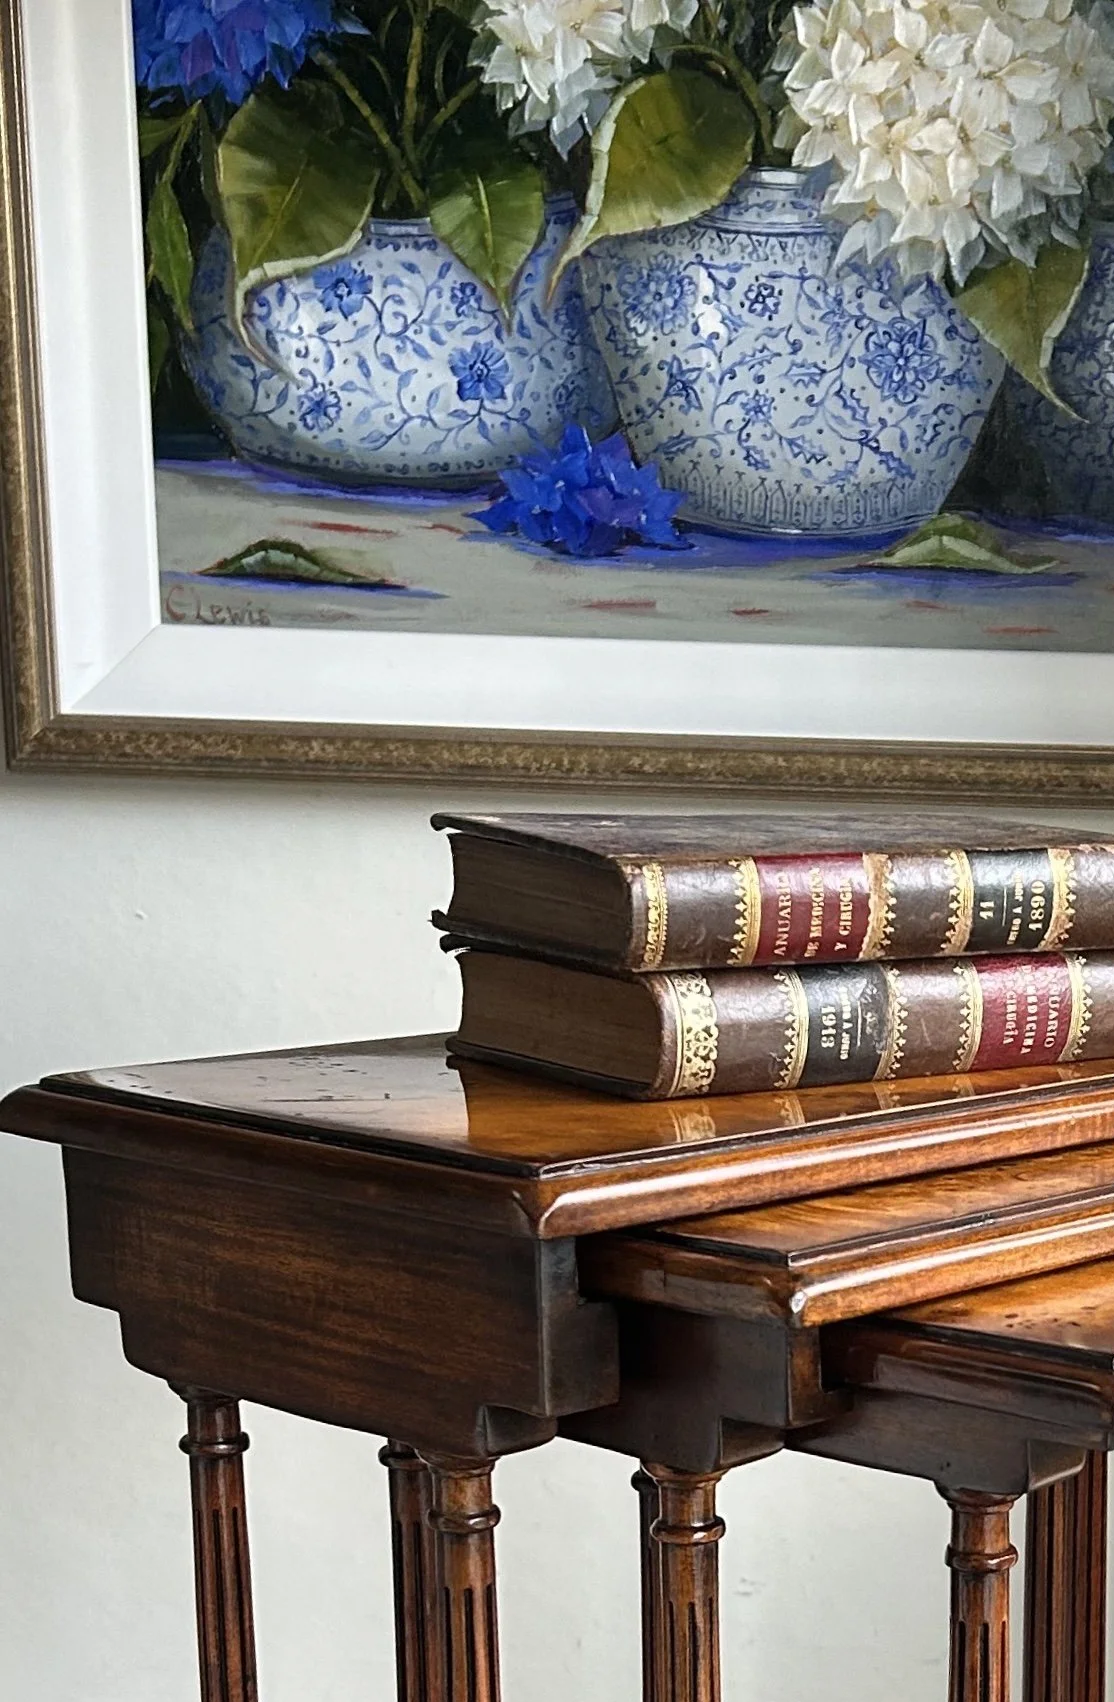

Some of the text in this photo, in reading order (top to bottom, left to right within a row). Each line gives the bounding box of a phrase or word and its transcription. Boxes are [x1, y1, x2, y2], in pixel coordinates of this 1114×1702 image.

[773, 871, 792, 956] ANUARIO
[979, 901, 995, 920] 11
[1028, 880, 1046, 931] 1890
[803, 941, 820, 958] DE
[834, 941, 847, 952] Y
[821, 1005, 837, 1048] 1913
[1020, 985, 1038, 1054] MEDICINA
[1044, 971, 1061, 1048] NUARIO
[839, 1031, 851, 1060] JUNIO
